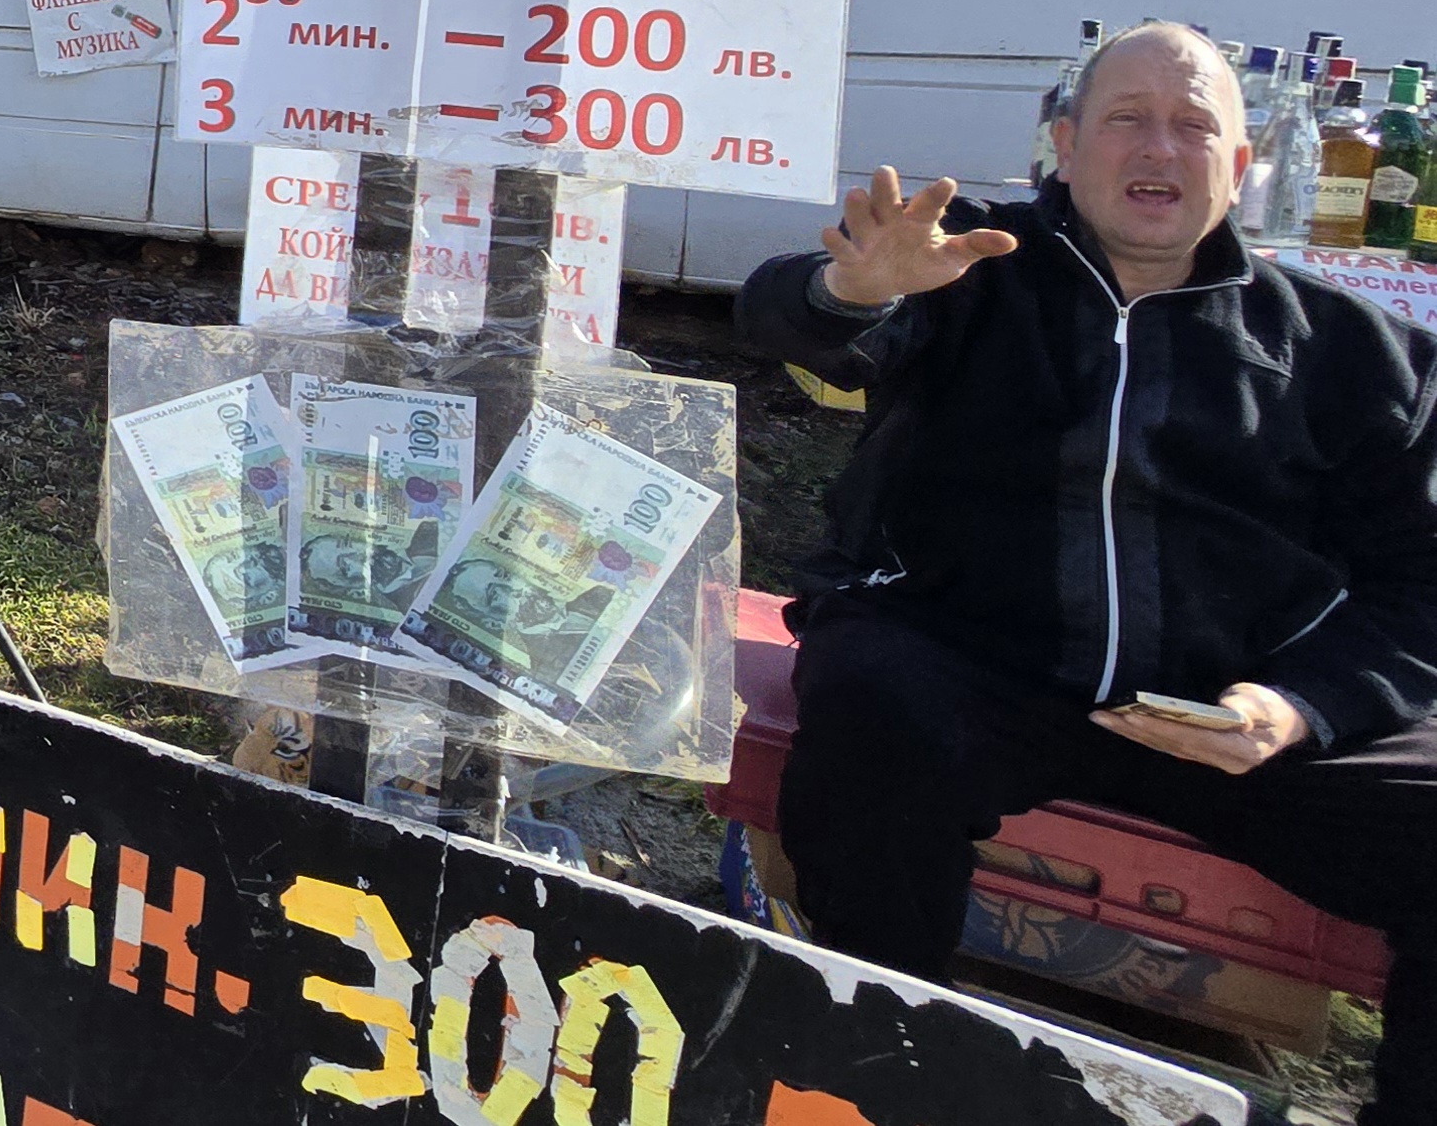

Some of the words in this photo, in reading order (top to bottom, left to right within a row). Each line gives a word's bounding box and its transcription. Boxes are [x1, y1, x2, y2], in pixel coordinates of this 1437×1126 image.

[55, 30, 141, 60] МУЗИКА
[67, 12, 82, 32] С
[287, 20, 391, 50] мин.
[523, 3, 687, 72] 200
[713, 48, 792, 80] лв.
[197, 78, 236, 133] 3
[283, 106, 385, 137] мин.
[521, 83, 684, 156] 300
[710, 136, 791, 168] лв.
[217, 402, 258, 451] 100
[408, 409, 440, 459] 100
[623, 482, 673, 534] 100
[279, 875, 686, 1126] 300
